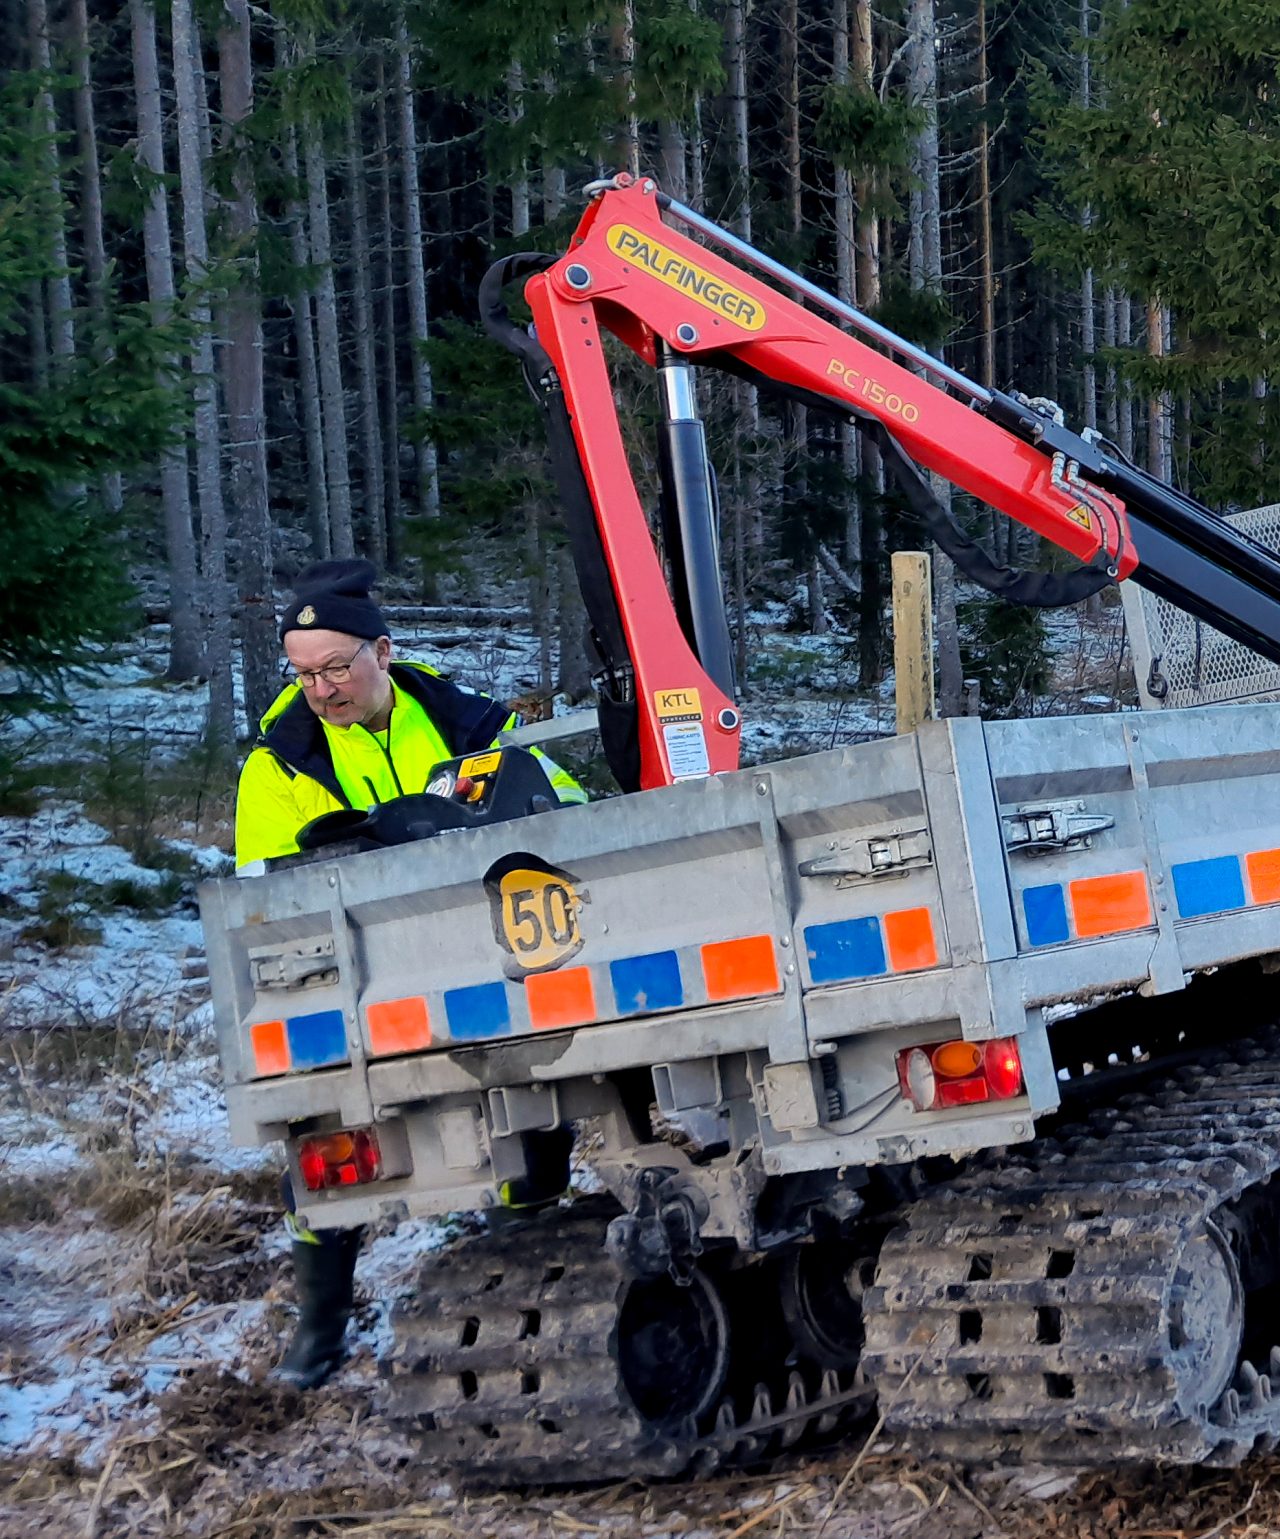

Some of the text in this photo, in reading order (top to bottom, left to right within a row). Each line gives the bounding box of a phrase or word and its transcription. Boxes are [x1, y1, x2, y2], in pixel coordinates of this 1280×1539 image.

[615, 230, 756, 325] PALFINGER
[826, 358, 919, 423] PC 1500
[661, 693, 692, 708] KTL
[510, 884, 574, 951] 50
